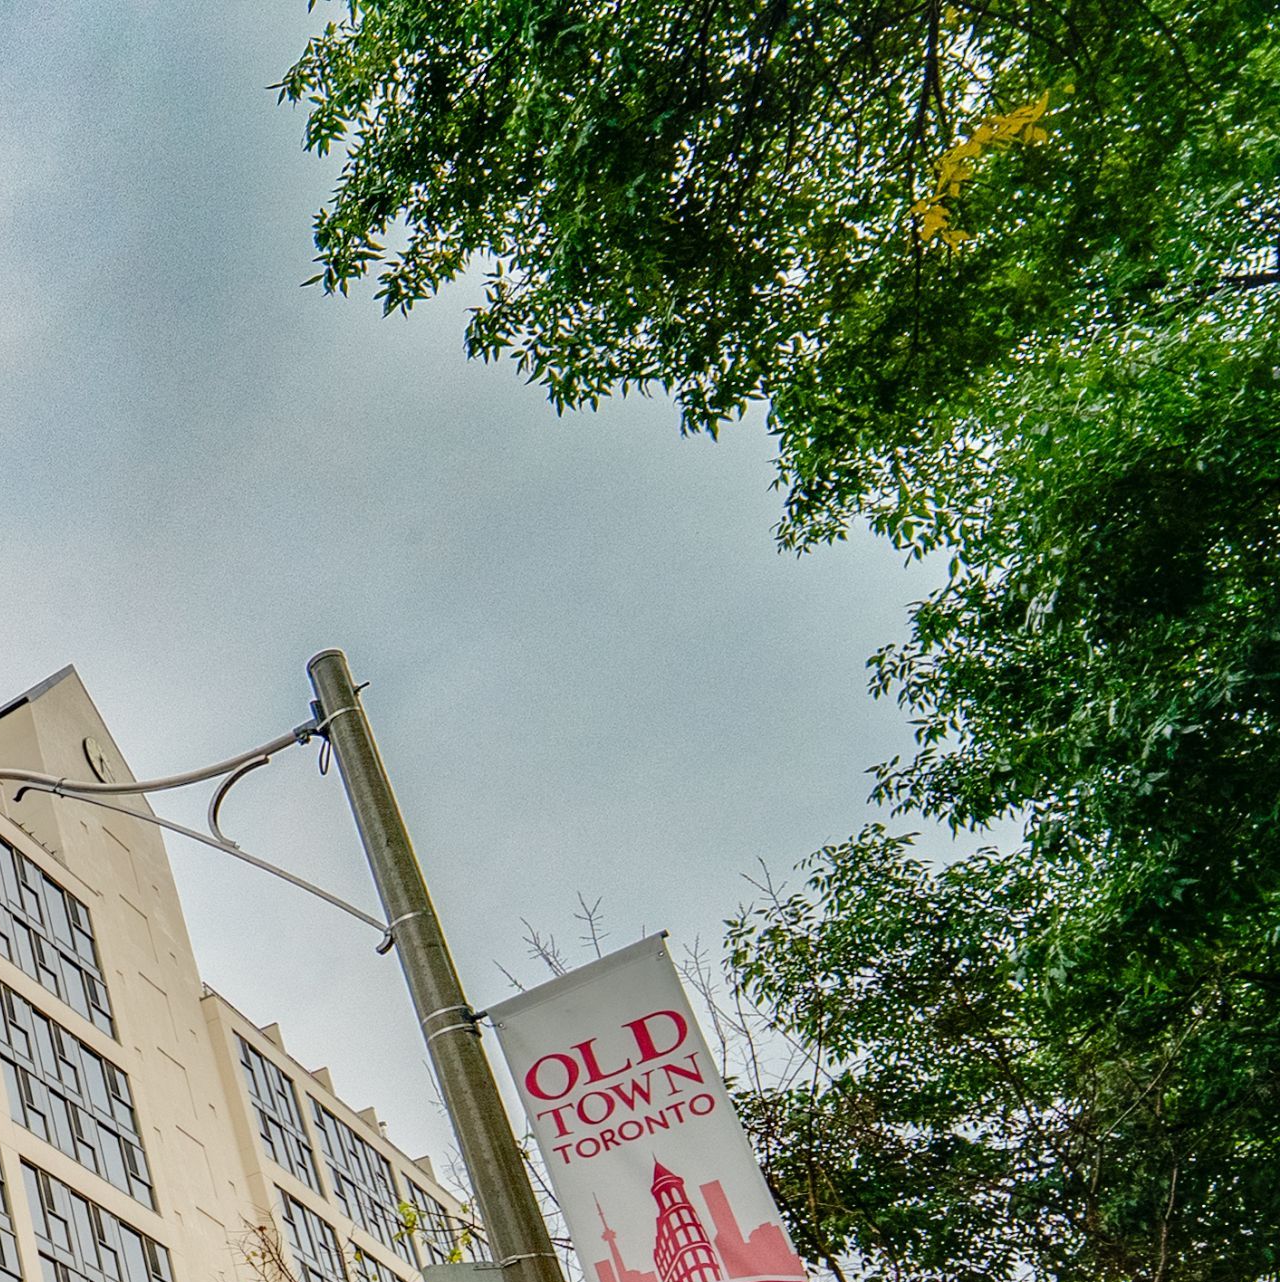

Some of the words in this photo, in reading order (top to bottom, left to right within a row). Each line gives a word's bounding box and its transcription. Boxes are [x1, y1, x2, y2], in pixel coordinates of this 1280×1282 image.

[525, 1010, 688, 1101] OLD
[537, 1052, 704, 1139] TOWN
[552, 1093, 715, 1165] TORONTO
